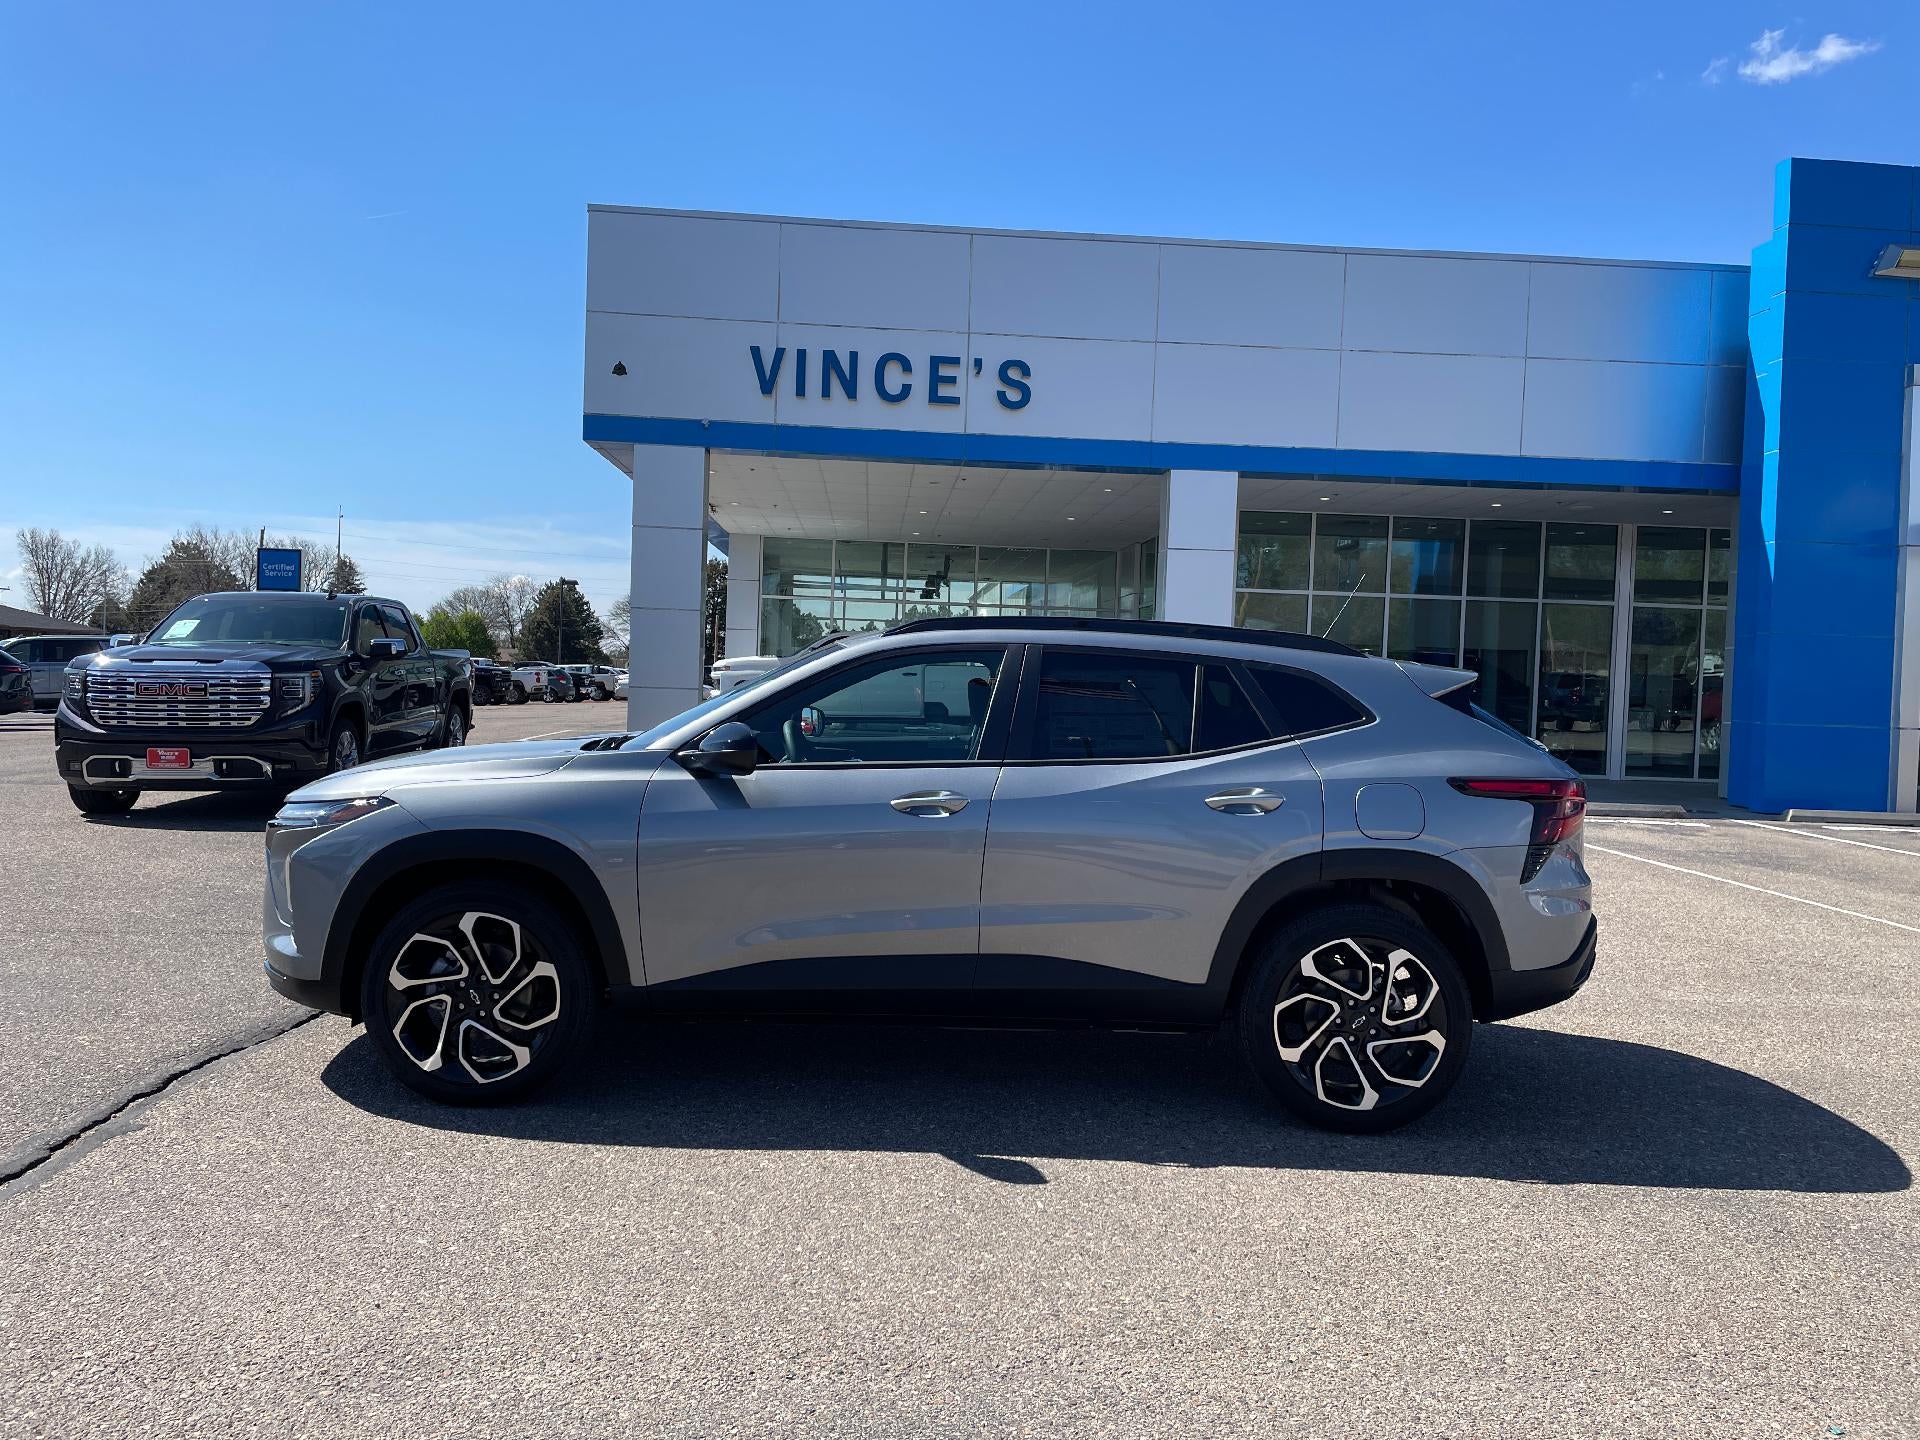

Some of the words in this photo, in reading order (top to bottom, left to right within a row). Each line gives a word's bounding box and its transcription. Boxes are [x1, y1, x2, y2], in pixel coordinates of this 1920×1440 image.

[749, 345, 1032, 411] VINCE'S
[262, 563, 295, 571] Certified
[264, 569, 293, 577] Service
[138, 683, 205, 696] GMC
